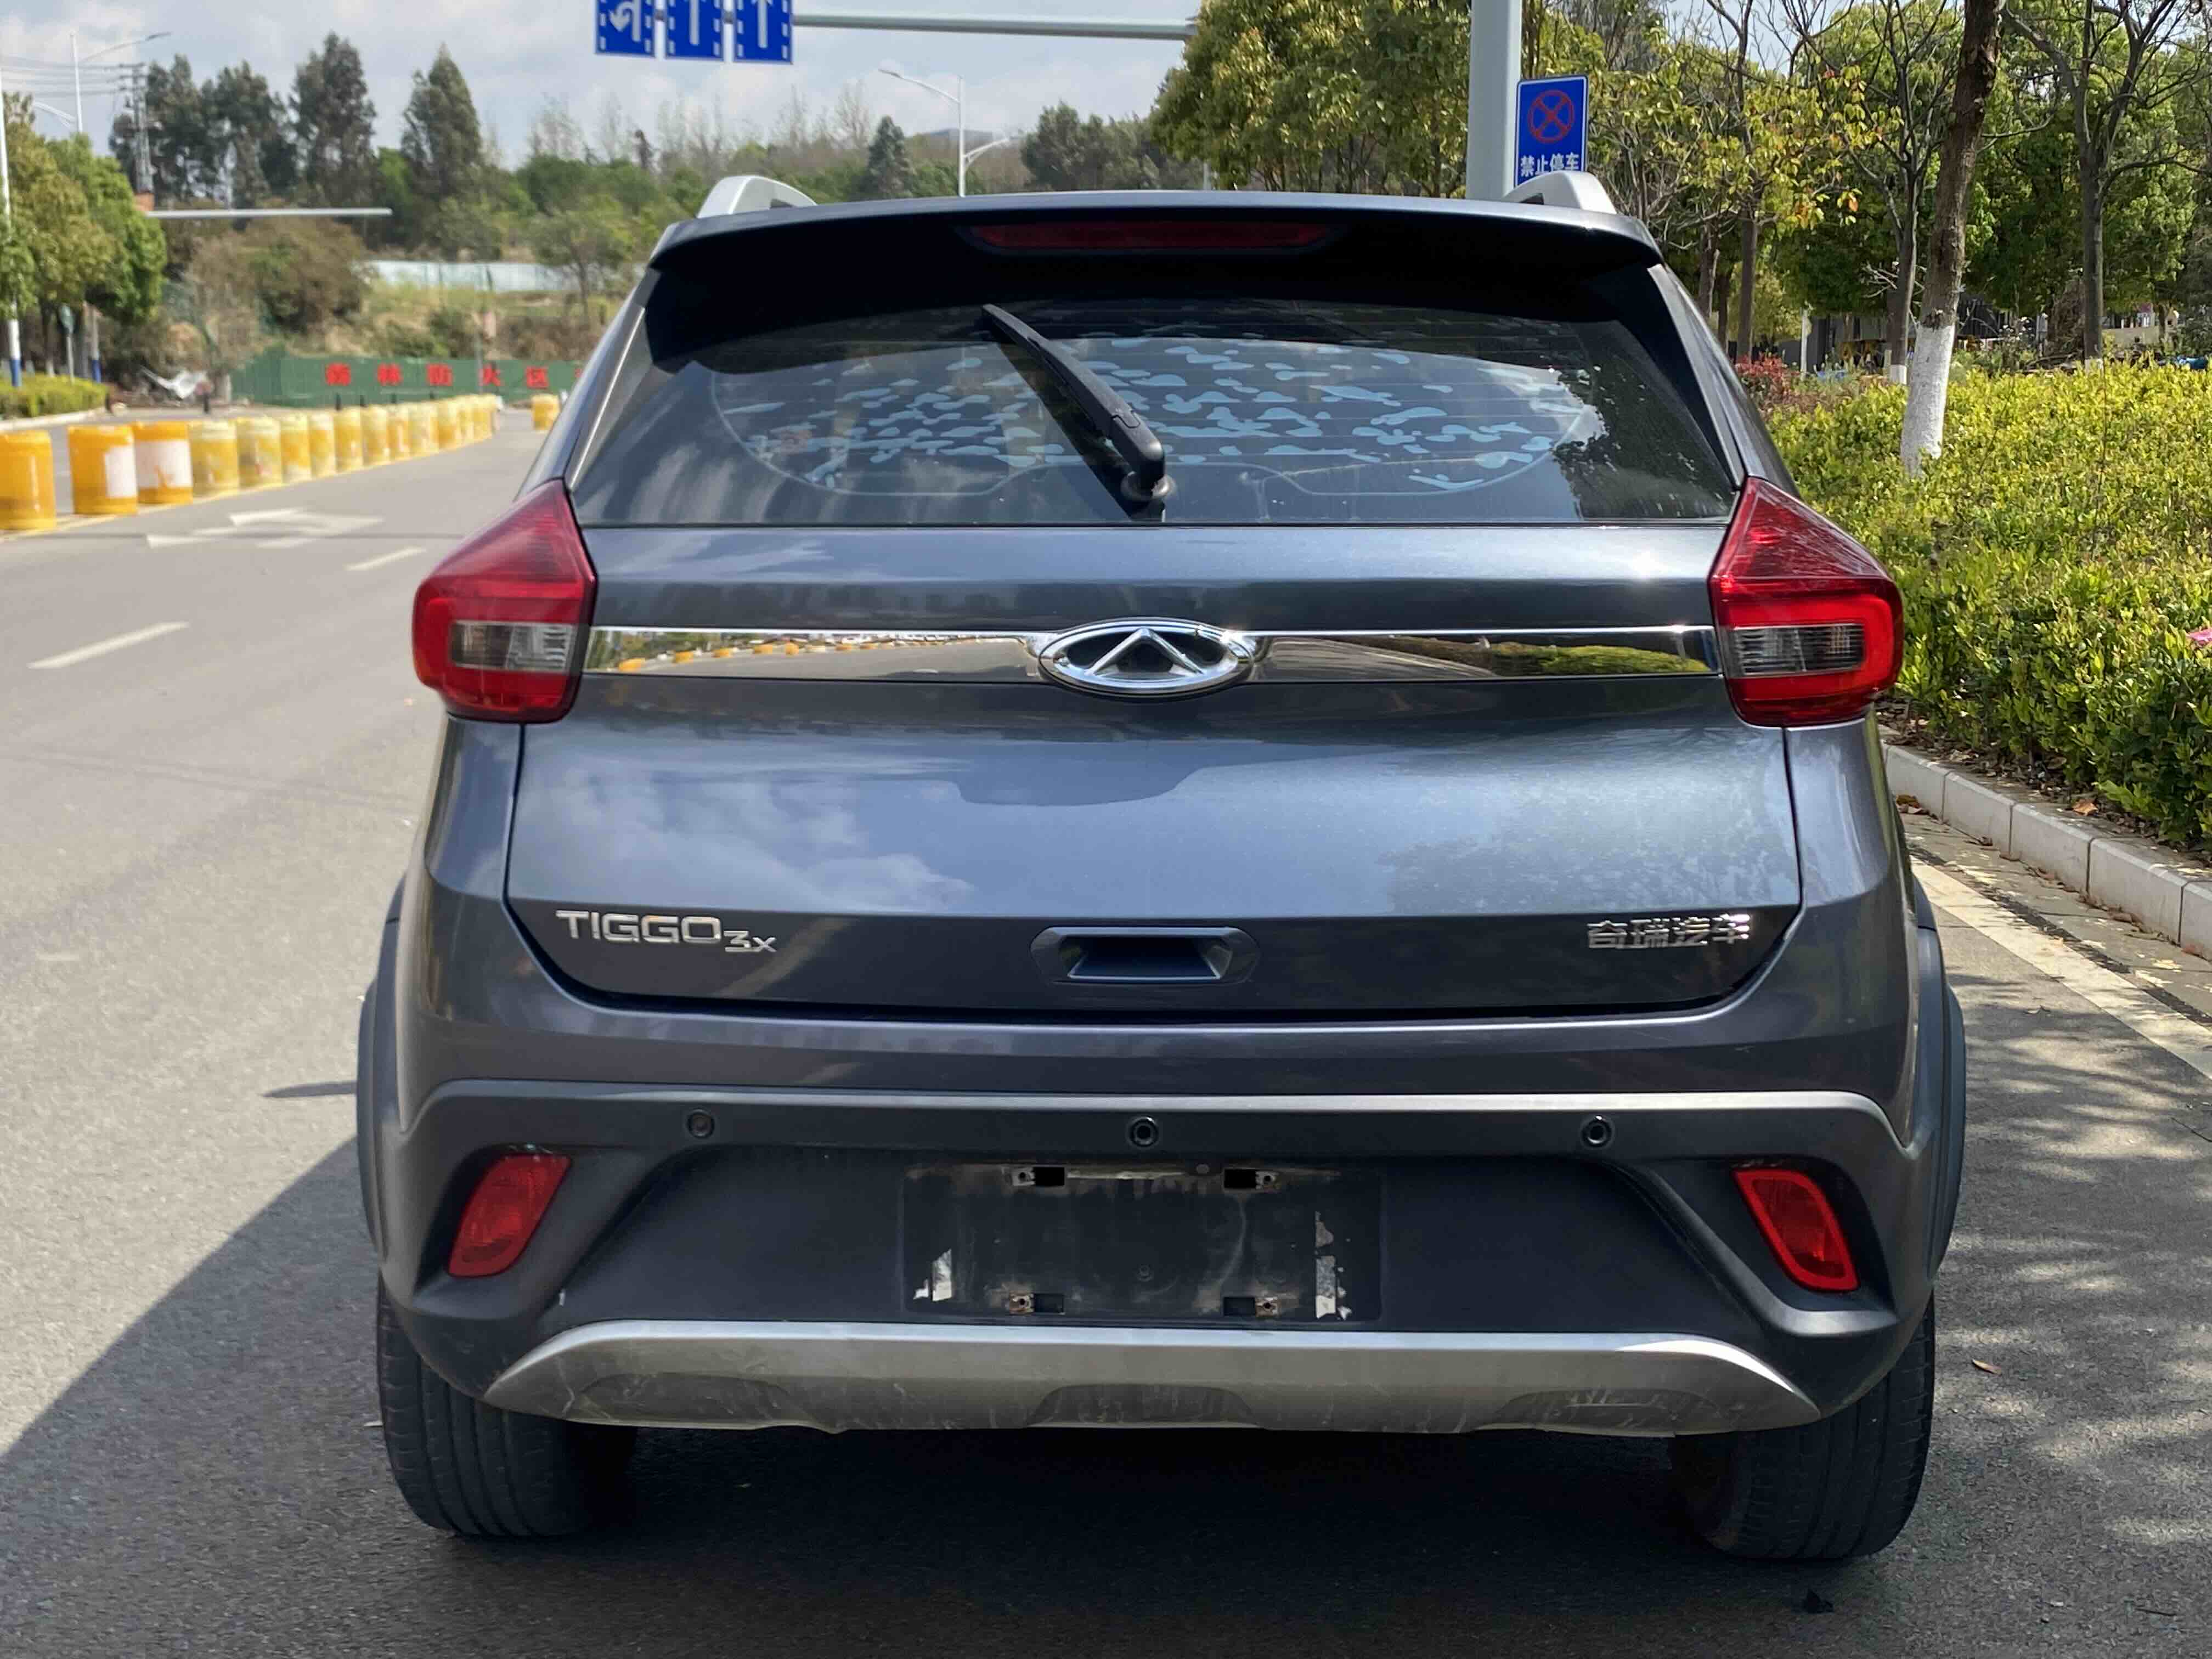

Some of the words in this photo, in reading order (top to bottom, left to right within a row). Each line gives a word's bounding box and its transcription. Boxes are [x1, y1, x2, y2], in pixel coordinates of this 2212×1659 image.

[1520, 152, 1579, 177] 禁止停车
[325, 363, 583, 389] 森林防火区
[1587, 913, 1750, 949] 奇瑞汽车
